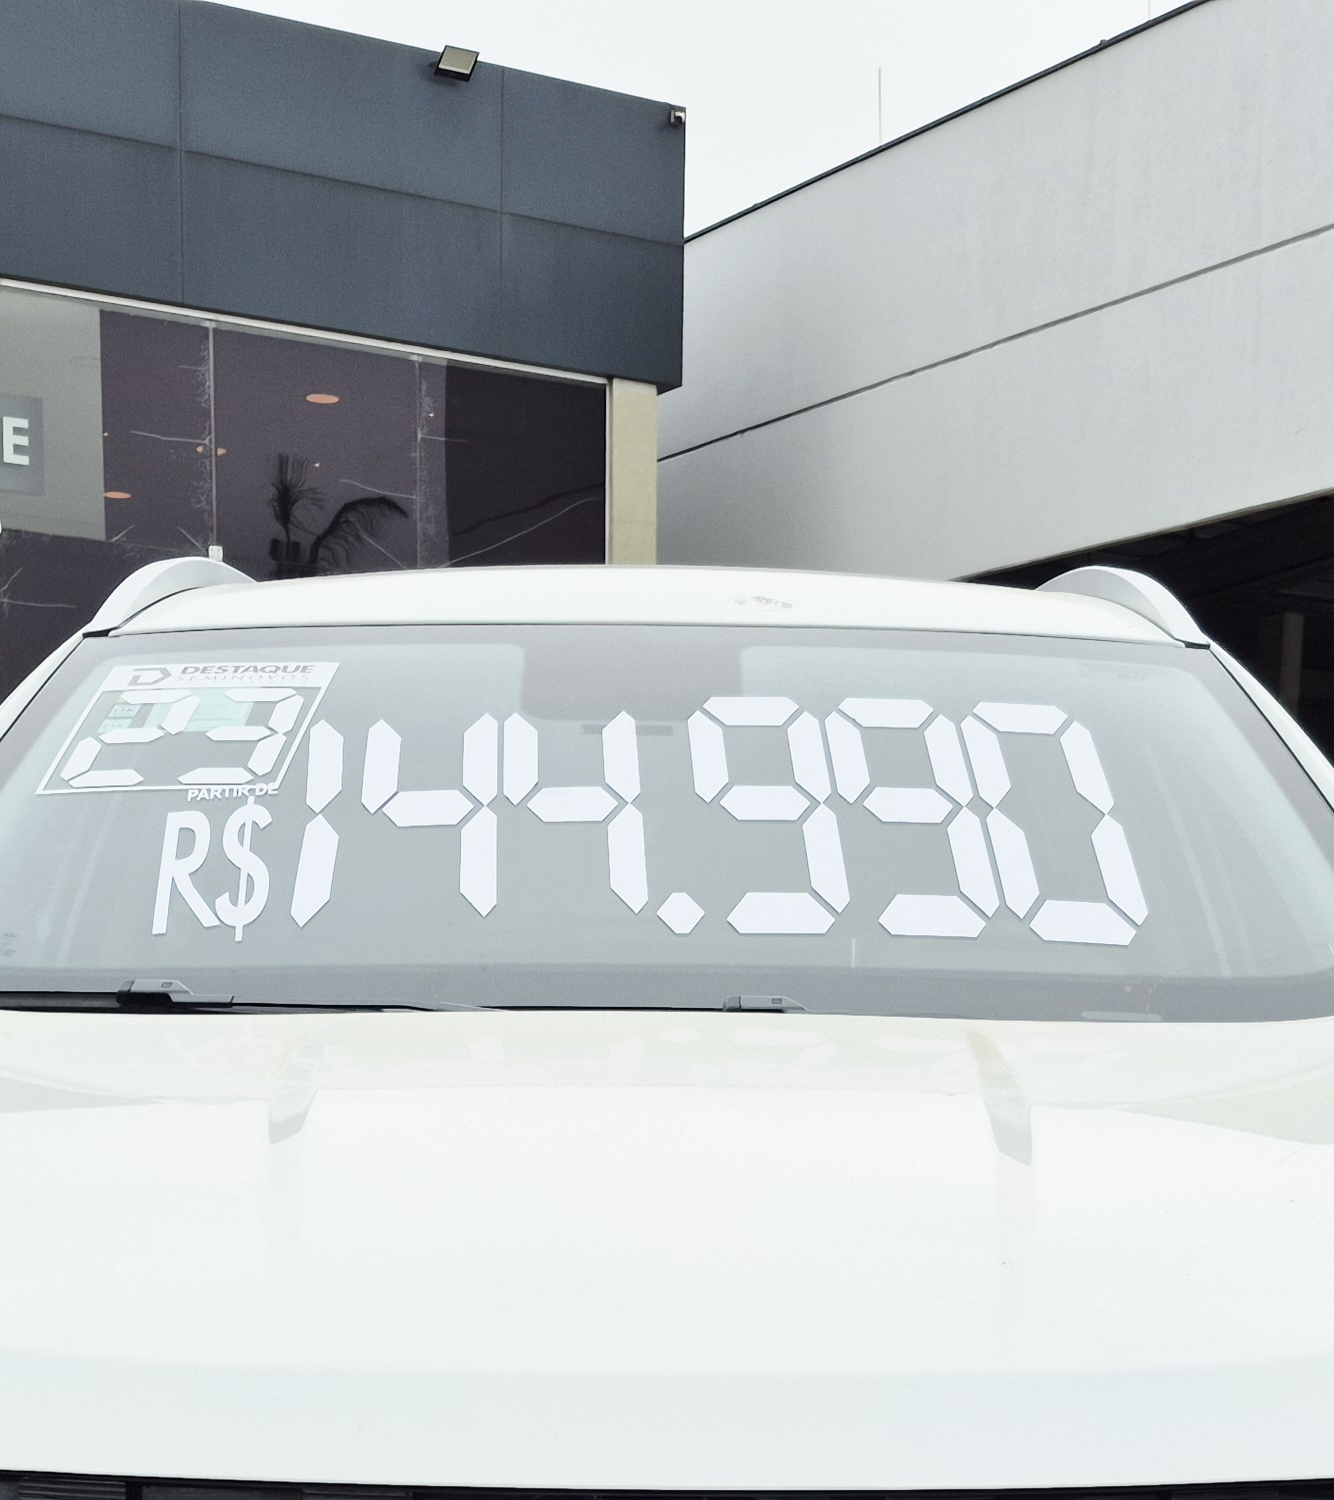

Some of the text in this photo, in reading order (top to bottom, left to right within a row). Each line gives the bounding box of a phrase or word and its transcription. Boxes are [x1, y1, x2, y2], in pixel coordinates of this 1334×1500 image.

[176, 674, 310, 683] SEMINOVOS
[180, 664, 315, 676] DESTAQUE
[60, 687, 305, 789] 23
[187, 783, 279, 802] PARTIR DE
[151, 695, 1150, 948] R$ 144.990
